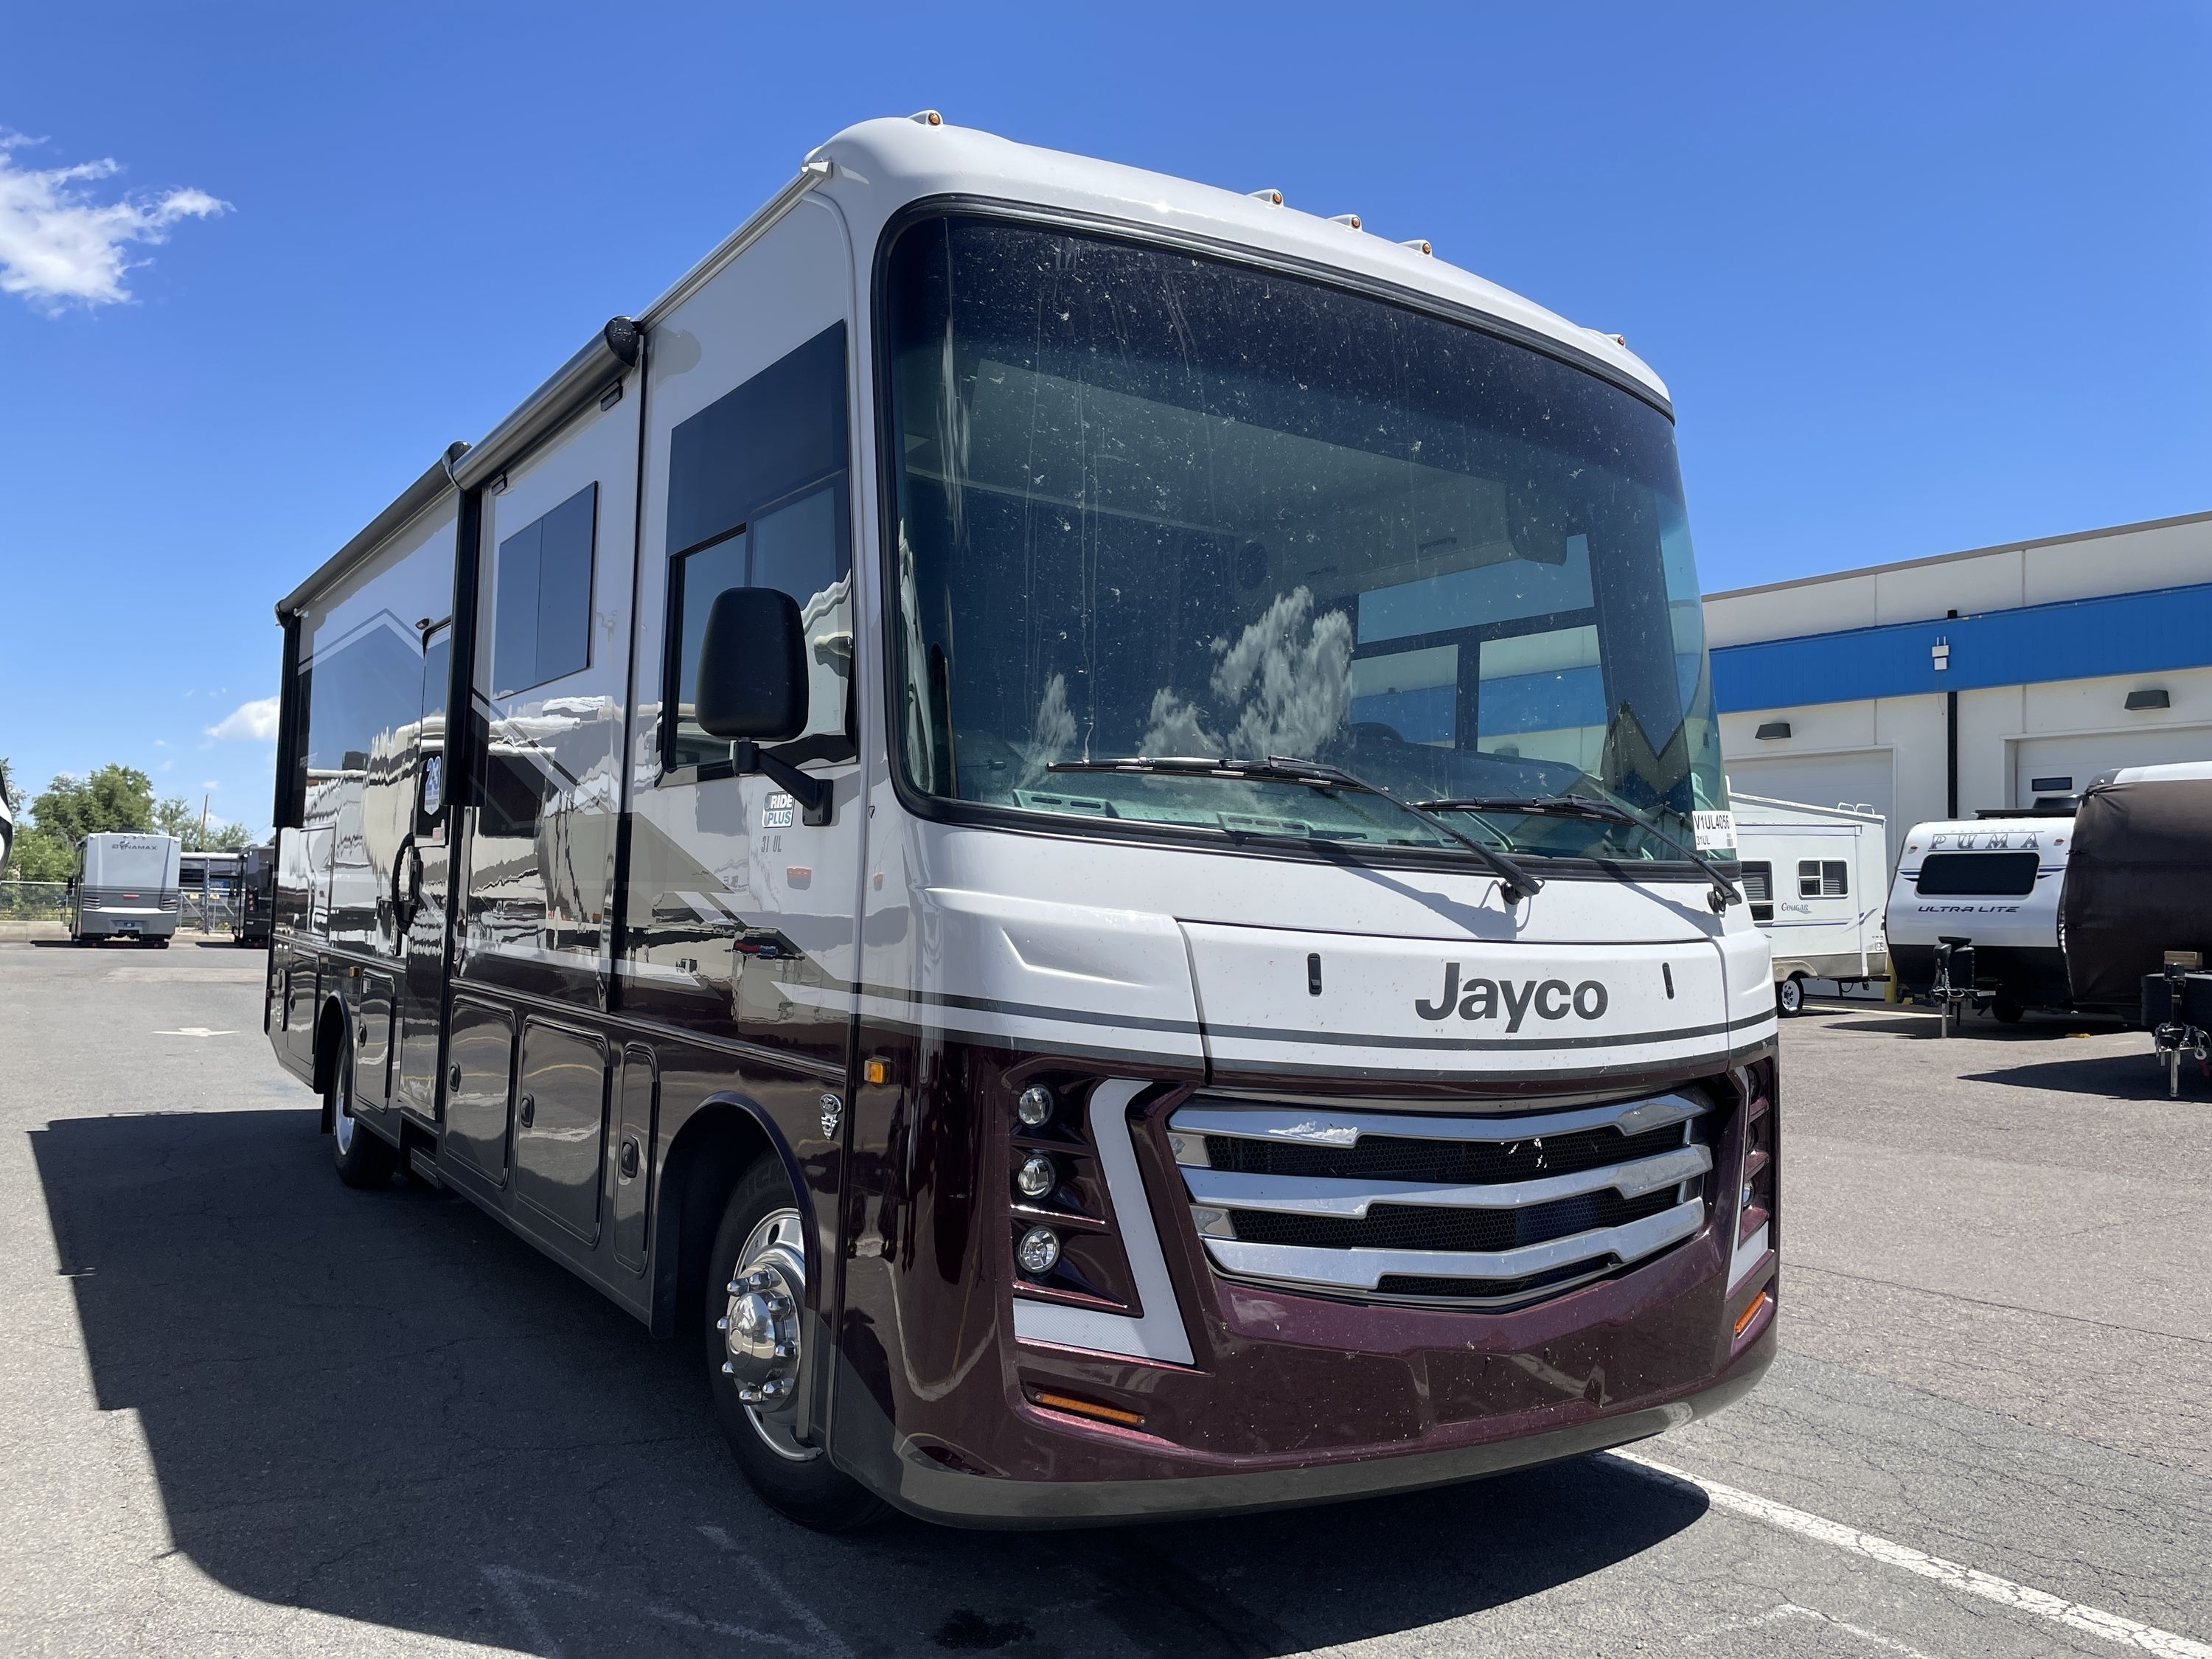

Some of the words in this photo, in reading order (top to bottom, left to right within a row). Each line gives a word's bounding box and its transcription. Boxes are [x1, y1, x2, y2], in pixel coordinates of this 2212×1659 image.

[768, 811, 791, 825] PLUS
[1694, 814, 1730, 830] V1UL4056
[761, 835, 770, 853] 31
[773, 835, 782, 852] UL
[1697, 835, 1711, 846] 31UL
[1929, 833, 2039, 849] PUMA
[1414, 961, 1609, 1034] Jayco
